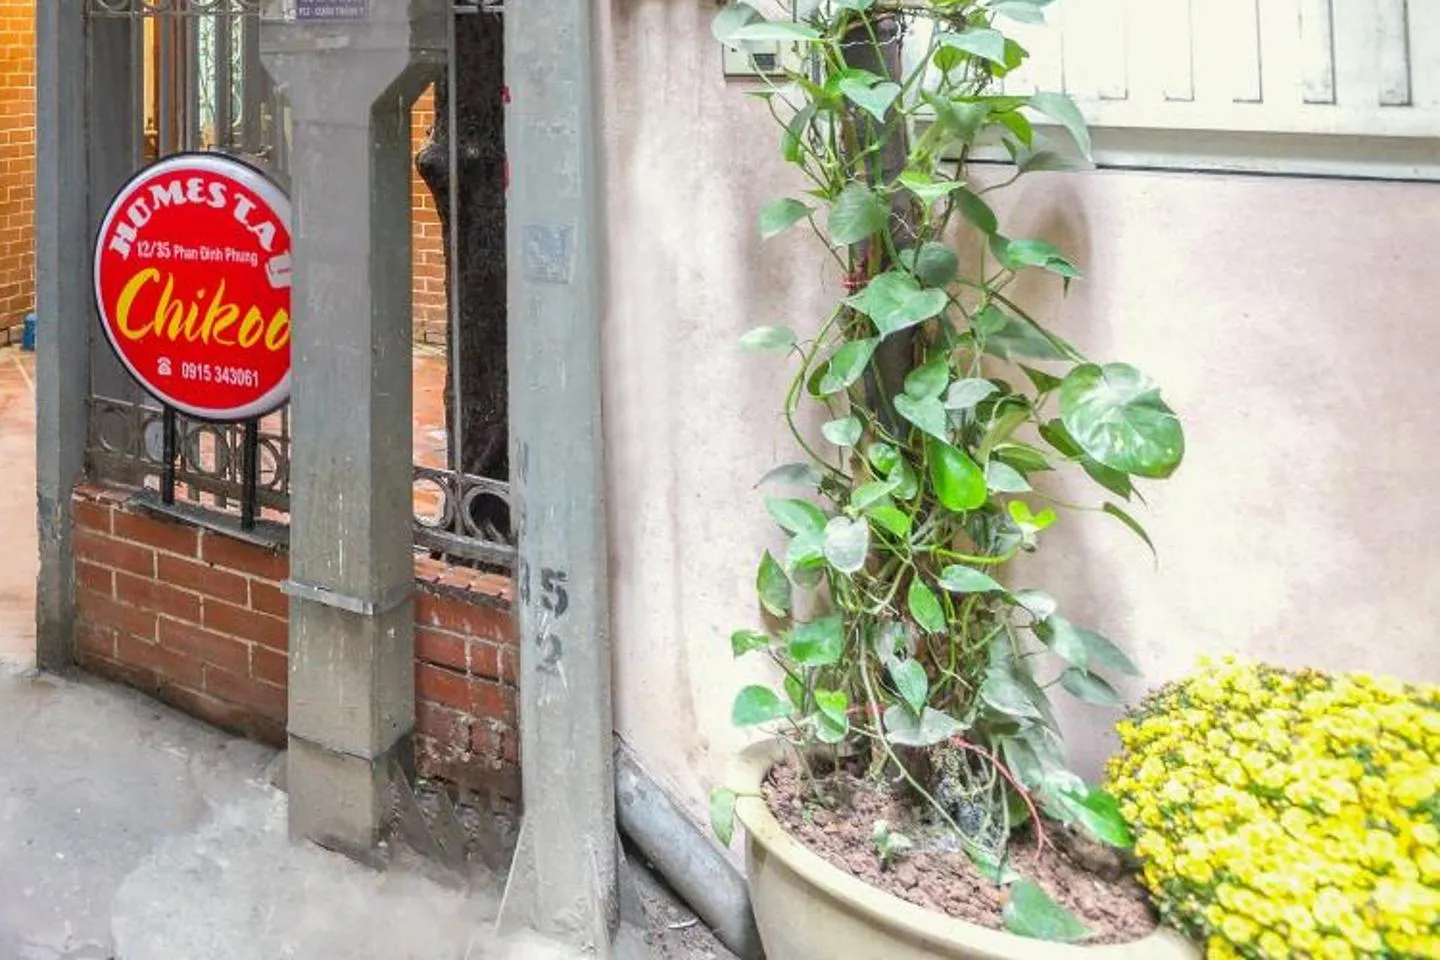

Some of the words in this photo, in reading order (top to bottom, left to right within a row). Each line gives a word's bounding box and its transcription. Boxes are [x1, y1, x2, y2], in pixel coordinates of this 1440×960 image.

[137, 240, 171, 259] 12/35
[173, 245, 199, 261] Phan
[116, 267, 292, 352] Chikoo
[181, 361, 212, 381] 0915
[214, 366, 259, 388] 343061
